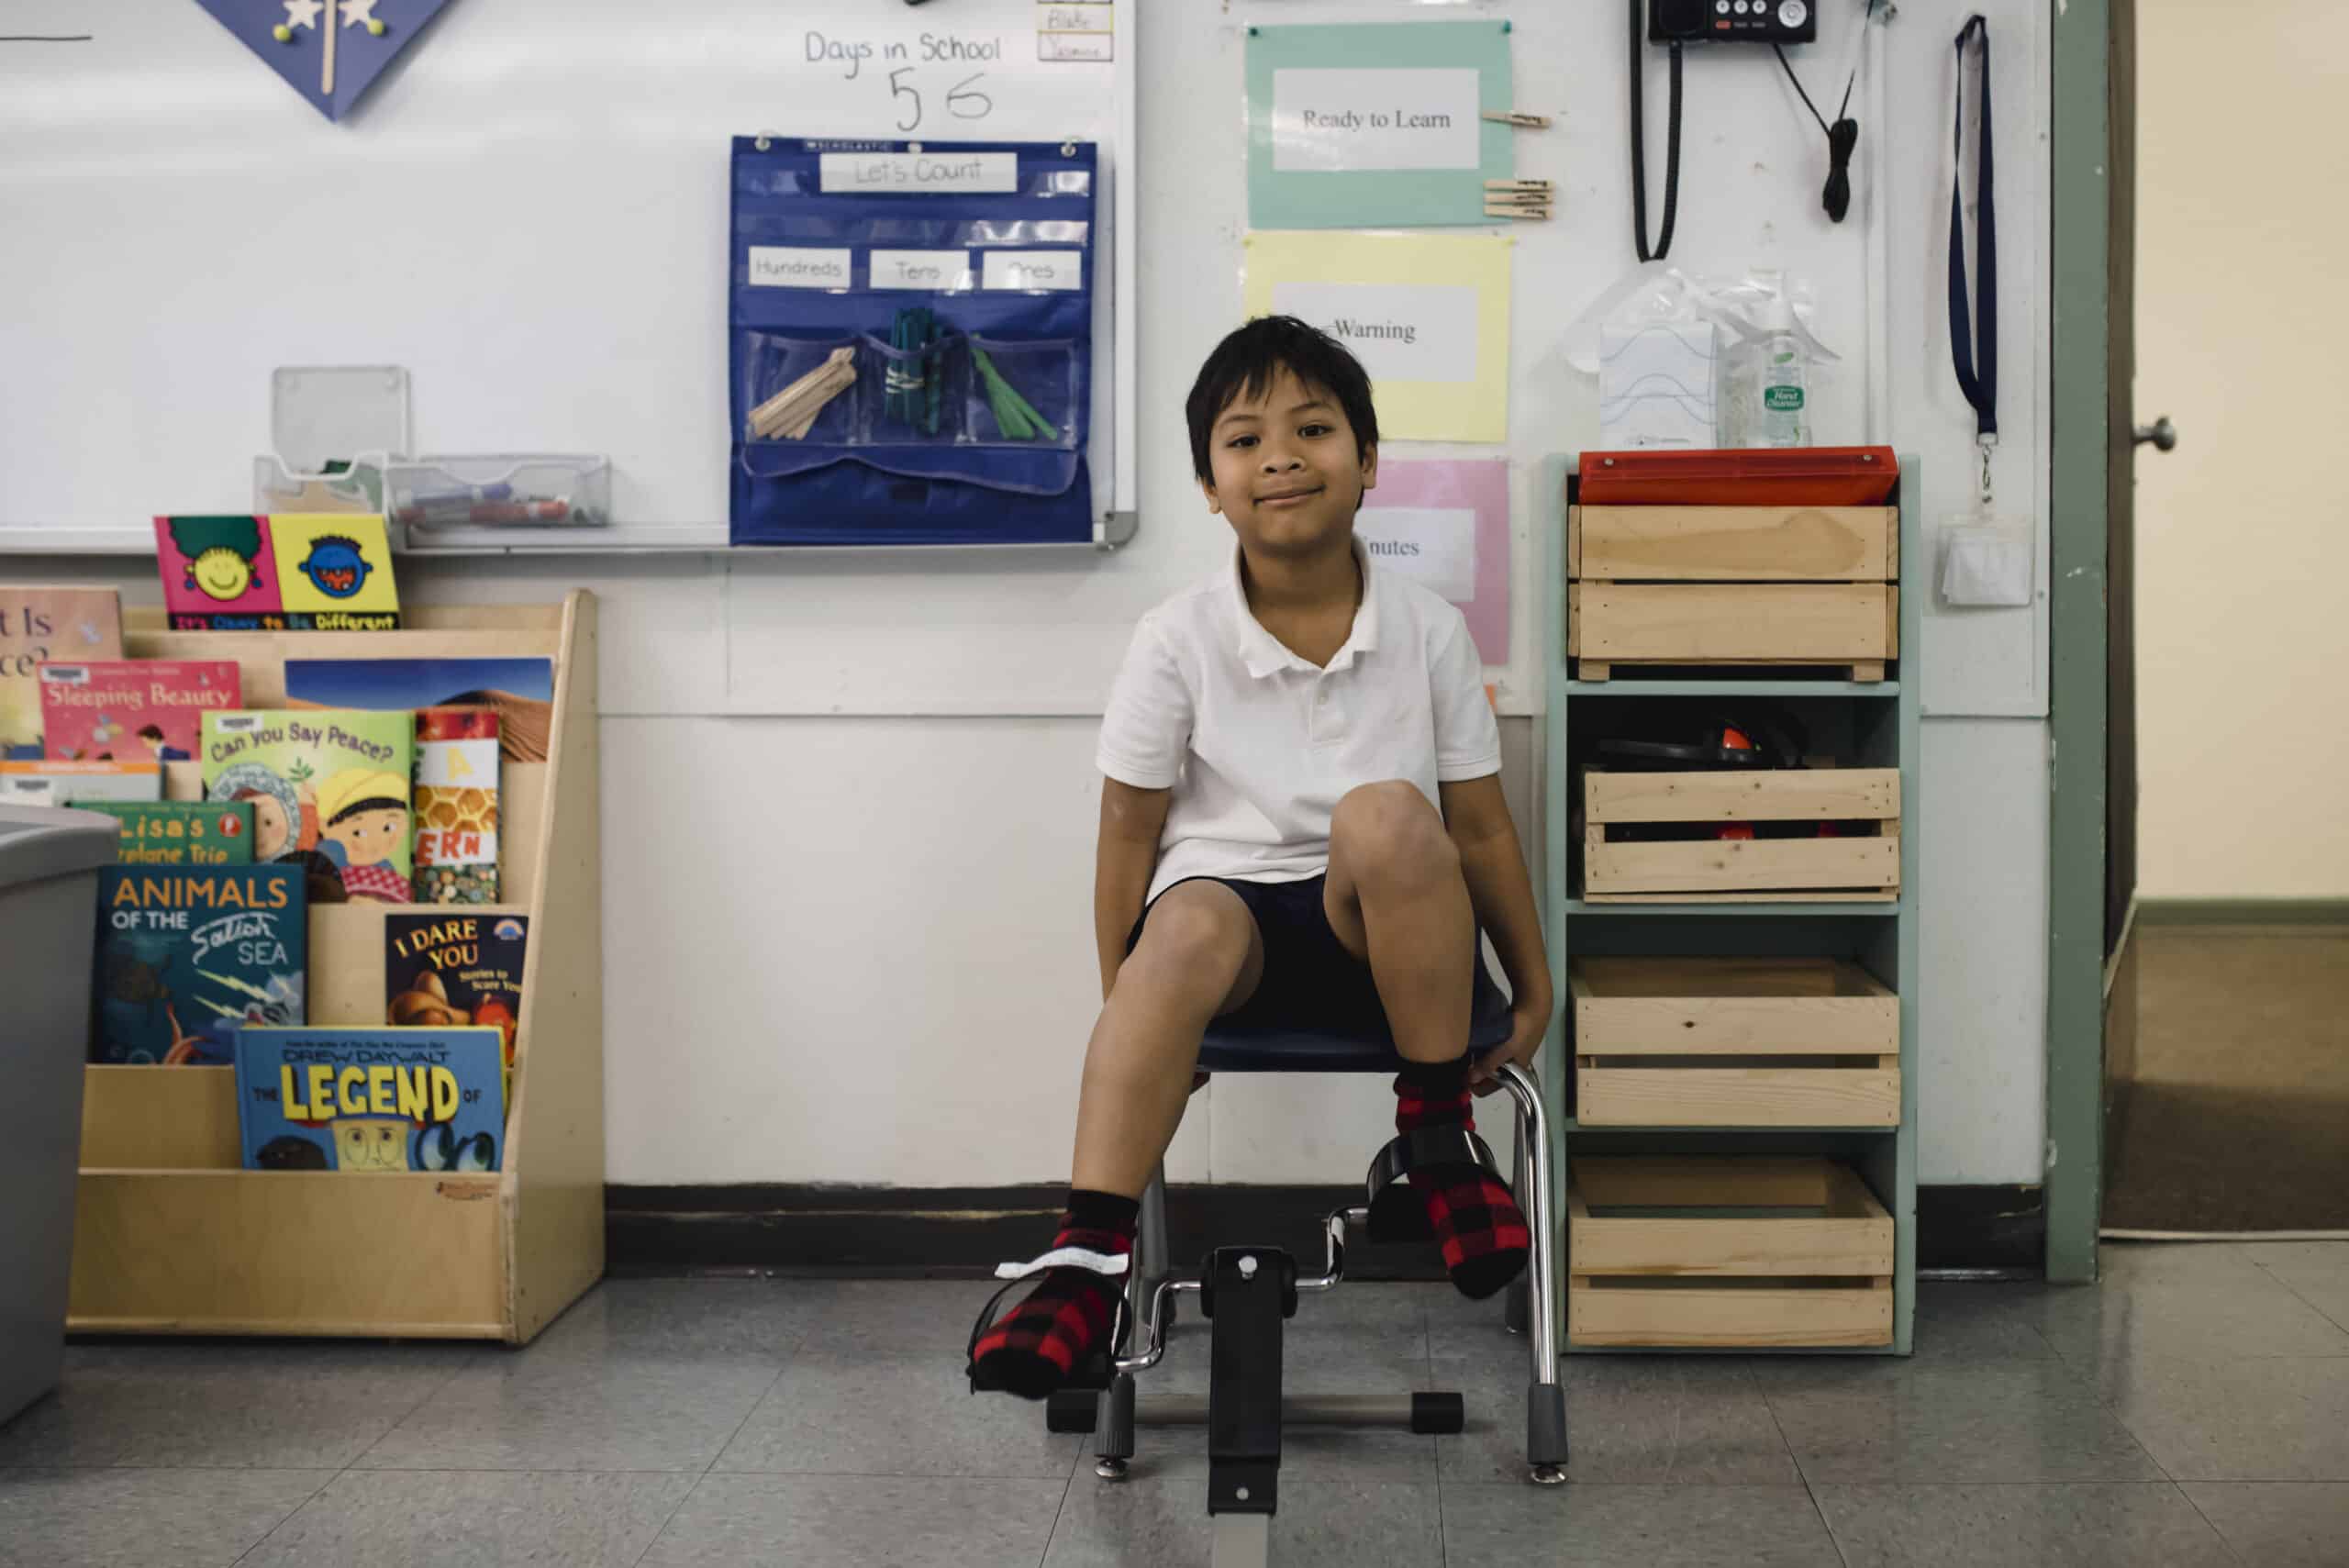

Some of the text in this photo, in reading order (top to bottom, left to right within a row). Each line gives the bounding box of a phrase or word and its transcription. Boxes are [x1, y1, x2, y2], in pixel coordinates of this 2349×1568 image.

[807, 32, 1001, 80] Days in School
[1303, 109, 1451, 132] Ready to Learn
[856, 157, 984, 184] Let's Count
[755, 260, 843, 278] Hundreds
[895, 261, 941, 280] Tens
[1334, 318, 1417, 344] Warning
[1369, 539, 1420, 556] nutes
[23, 606, 52, 638] Is
[262, 614, 284, 631] to
[316, 614, 395, 631] Different
[48, 682, 231, 711] Sleeping Beauty
[210, 734, 247, 762] Can
[289, 721, 323, 749] Say
[328, 725, 395, 763] Peace?
[117, 811, 205, 839] Lisa's
[117, 841, 229, 865] rplane Trip
[112, 876, 289, 909] ANIMALS
[111, 910, 191, 930] OF THE
[395, 918, 479, 959] I DARE
[238, 941, 290, 965] SEA
[428, 943, 479, 970] YOU
[282, 1049, 451, 1064] DREW DAYWALT
[252, 1064, 482, 1122] THE LEGEND OF
